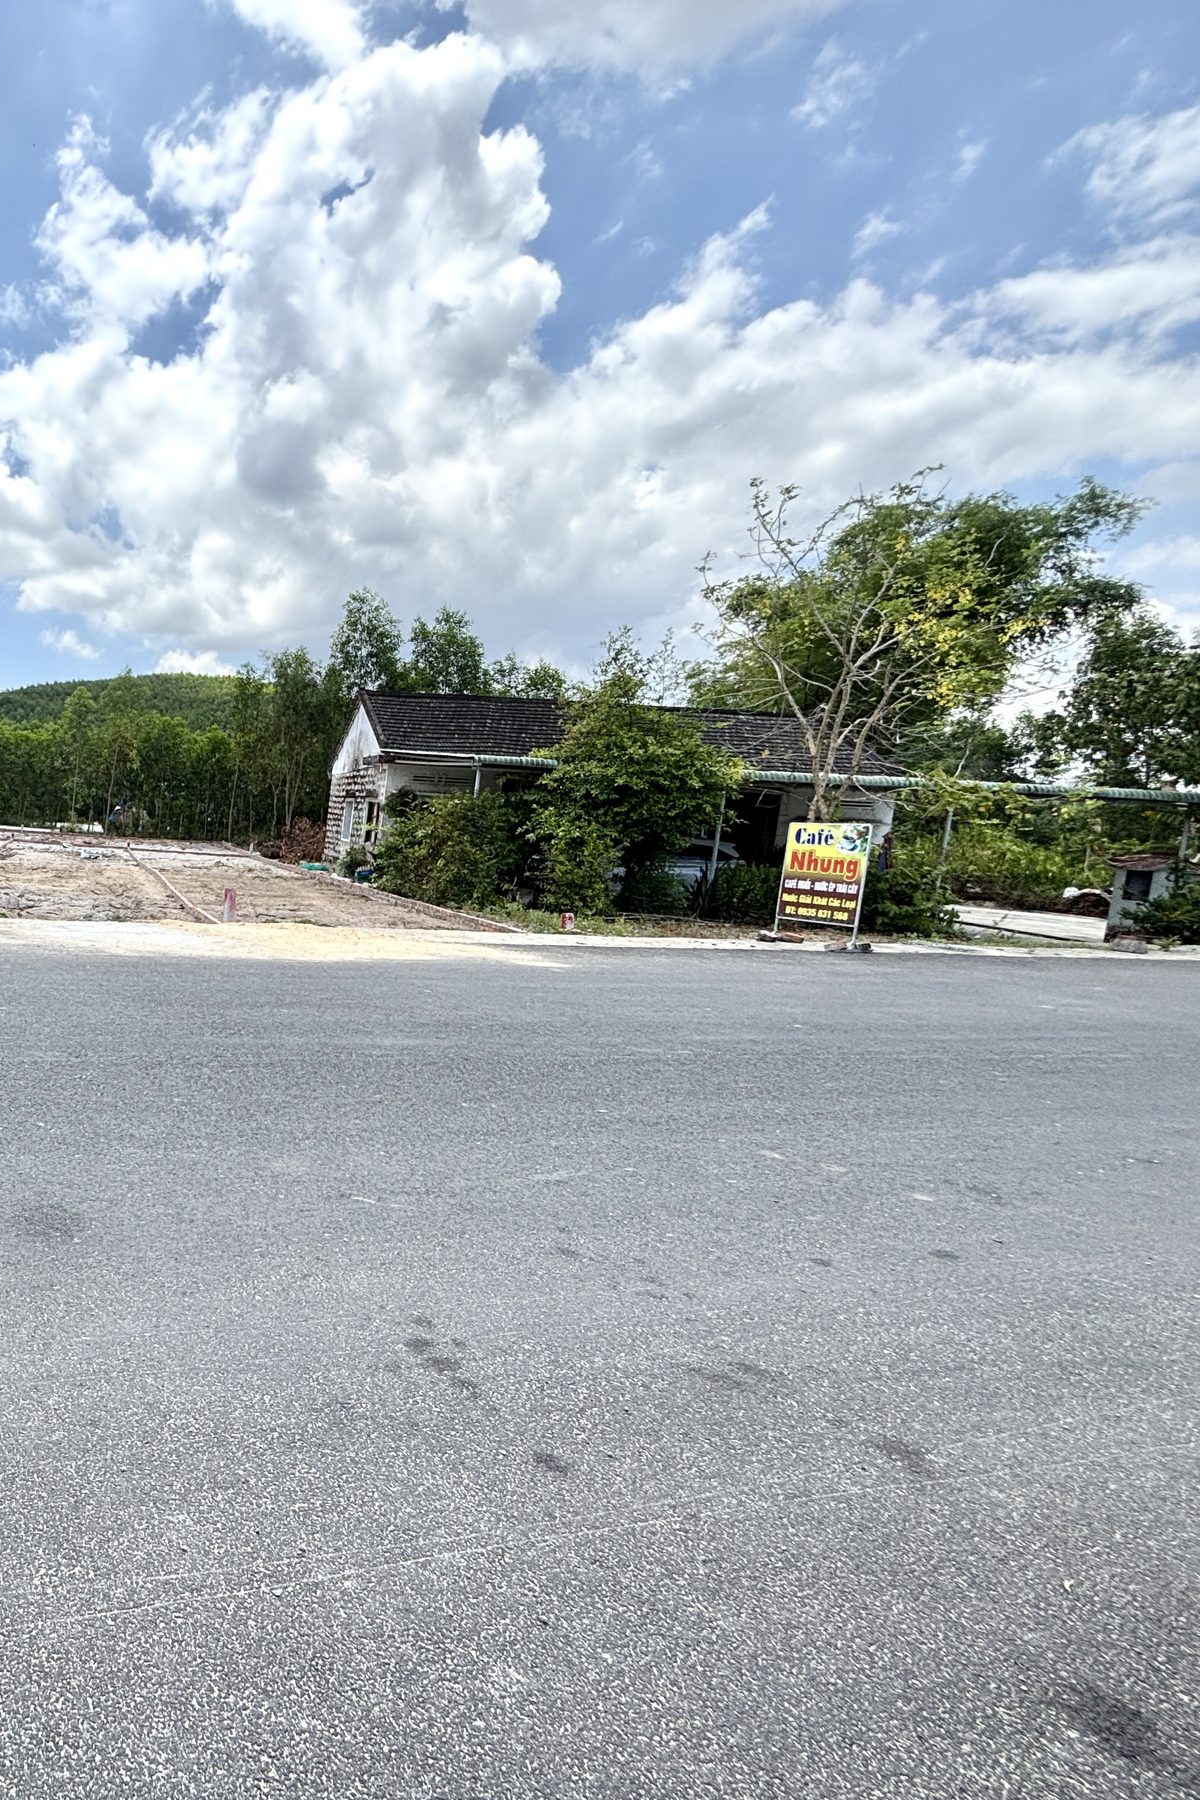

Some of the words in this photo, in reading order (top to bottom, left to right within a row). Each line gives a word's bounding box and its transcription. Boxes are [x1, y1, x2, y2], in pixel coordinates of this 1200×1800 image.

[795, 827, 835, 846] Café
[789, 850, 859, 880] Nhung
[842, 899, 856, 910] Loại
